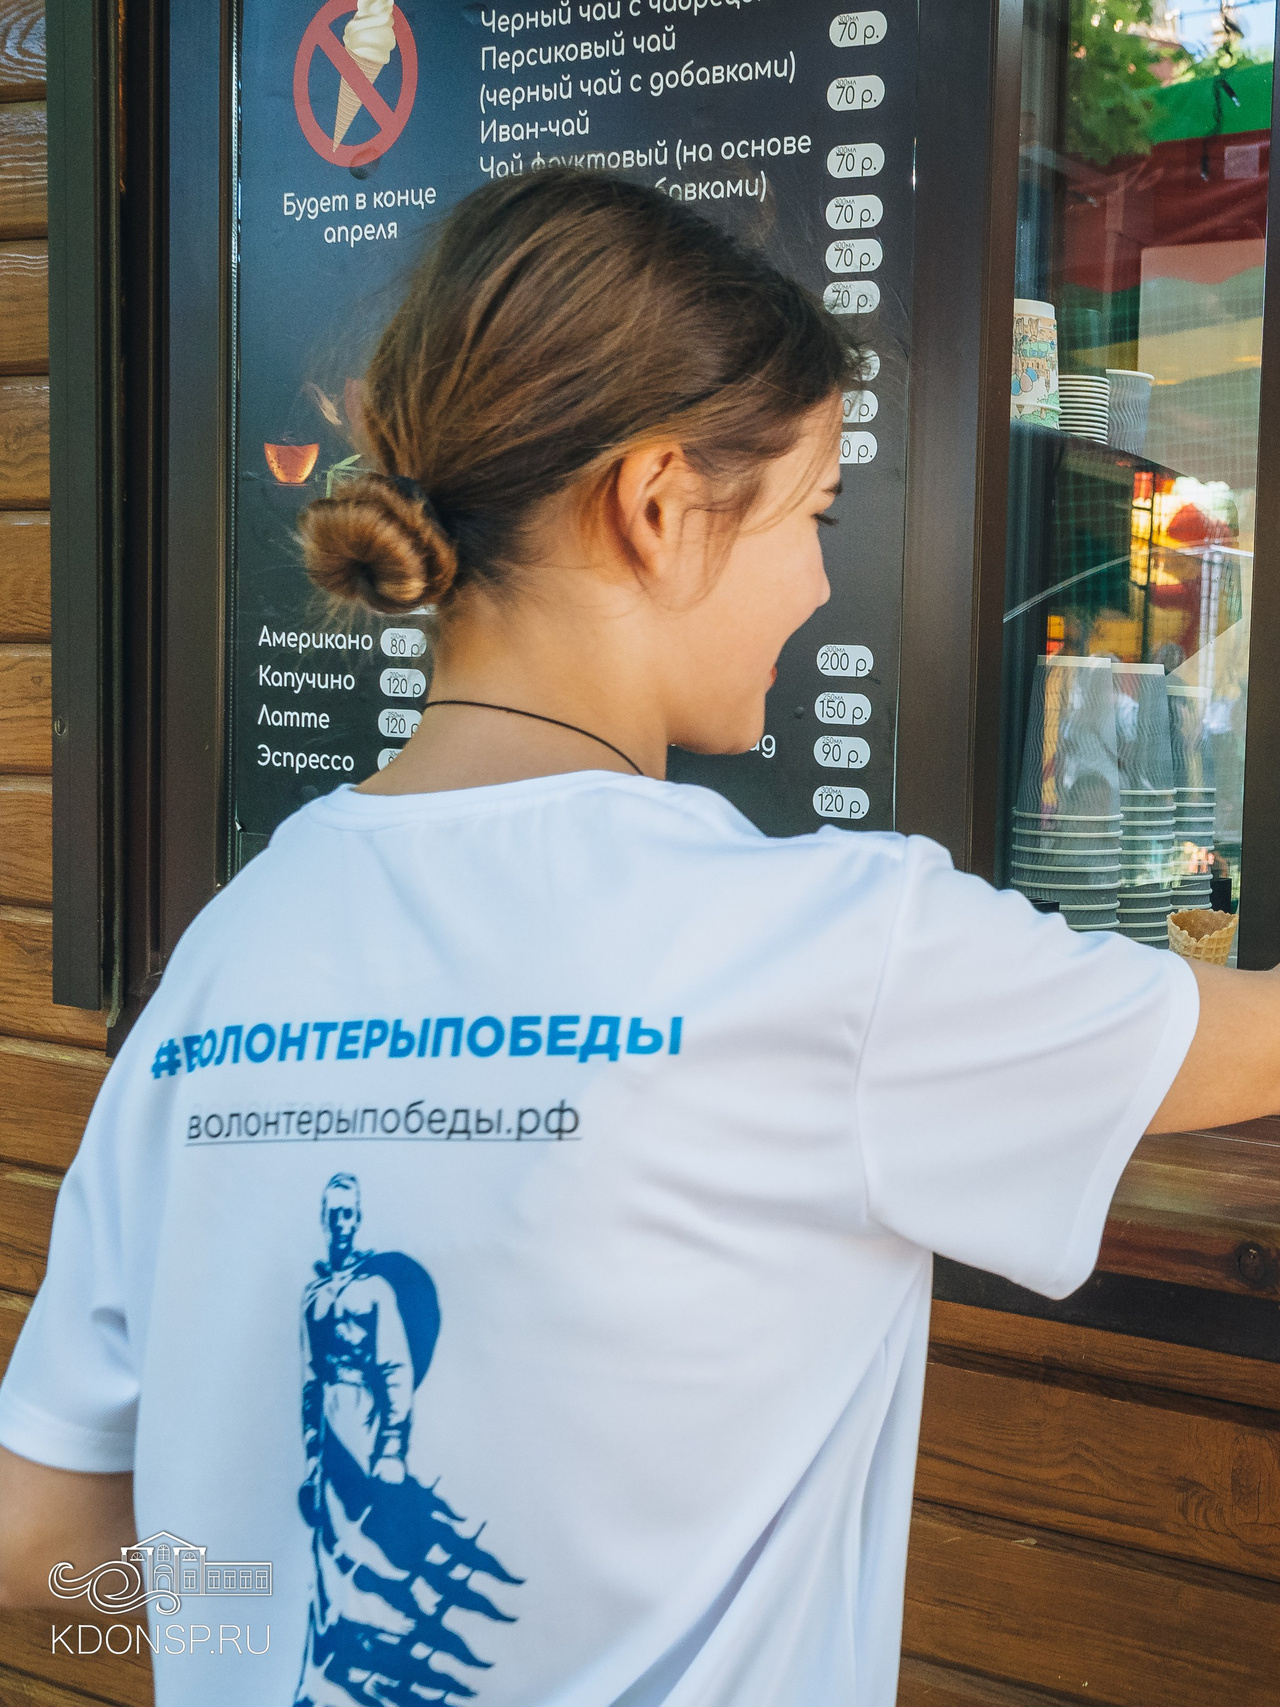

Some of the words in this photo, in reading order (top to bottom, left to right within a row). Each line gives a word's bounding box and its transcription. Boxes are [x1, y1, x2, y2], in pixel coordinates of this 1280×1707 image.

[481, 0, 571, 37] Черный
[629, 0, 641, 16] с
[838, 22, 857, 42] 70
[481, 30, 625, 74] Персиковый
[633, 25, 676, 53] чай
[480, 74, 572, 114] (черный
[580, 69, 622, 96] чай
[630, 74, 642, 92] с
[650, 51, 796, 97] добавками)
[836, 85, 855, 106] 70
[480, 109, 589, 144] Иван-чай
[480, 152, 523, 179] Чай
[676, 138, 713, 170] (на
[721, 135, 812, 160] основе
[836, 152, 855, 173] 70
[283, 192, 349, 221] Будет
[355, 193, 366, 210] в
[373, 187, 436, 210] конце
[834, 204, 854, 224] 70
[324, 222, 398, 248] апреля
[834, 248, 853, 268] 70
[831, 289, 850, 310] 70
[858, 403, 874, 422] р.
[858, 444, 873, 463] р.
[258, 625, 373, 654] Американо
[390, 639, 406, 655] 80
[820, 652, 849, 671] 200
[258, 664, 355, 694] Капучино
[387, 678, 407, 695] 120
[257, 704, 330, 729] Латте
[819, 700, 846, 719] 150
[385, 717, 406, 734] 120
[257, 744, 354, 774] Эспрессо
[821, 743, 841, 761] 90
[818, 793, 844, 813] 120
[150, 1013, 683, 1079] #ВОЛОНТЕРЫПОБЕДЫ
[187, 1098, 582, 1142] волонтерыпобеды.рф
